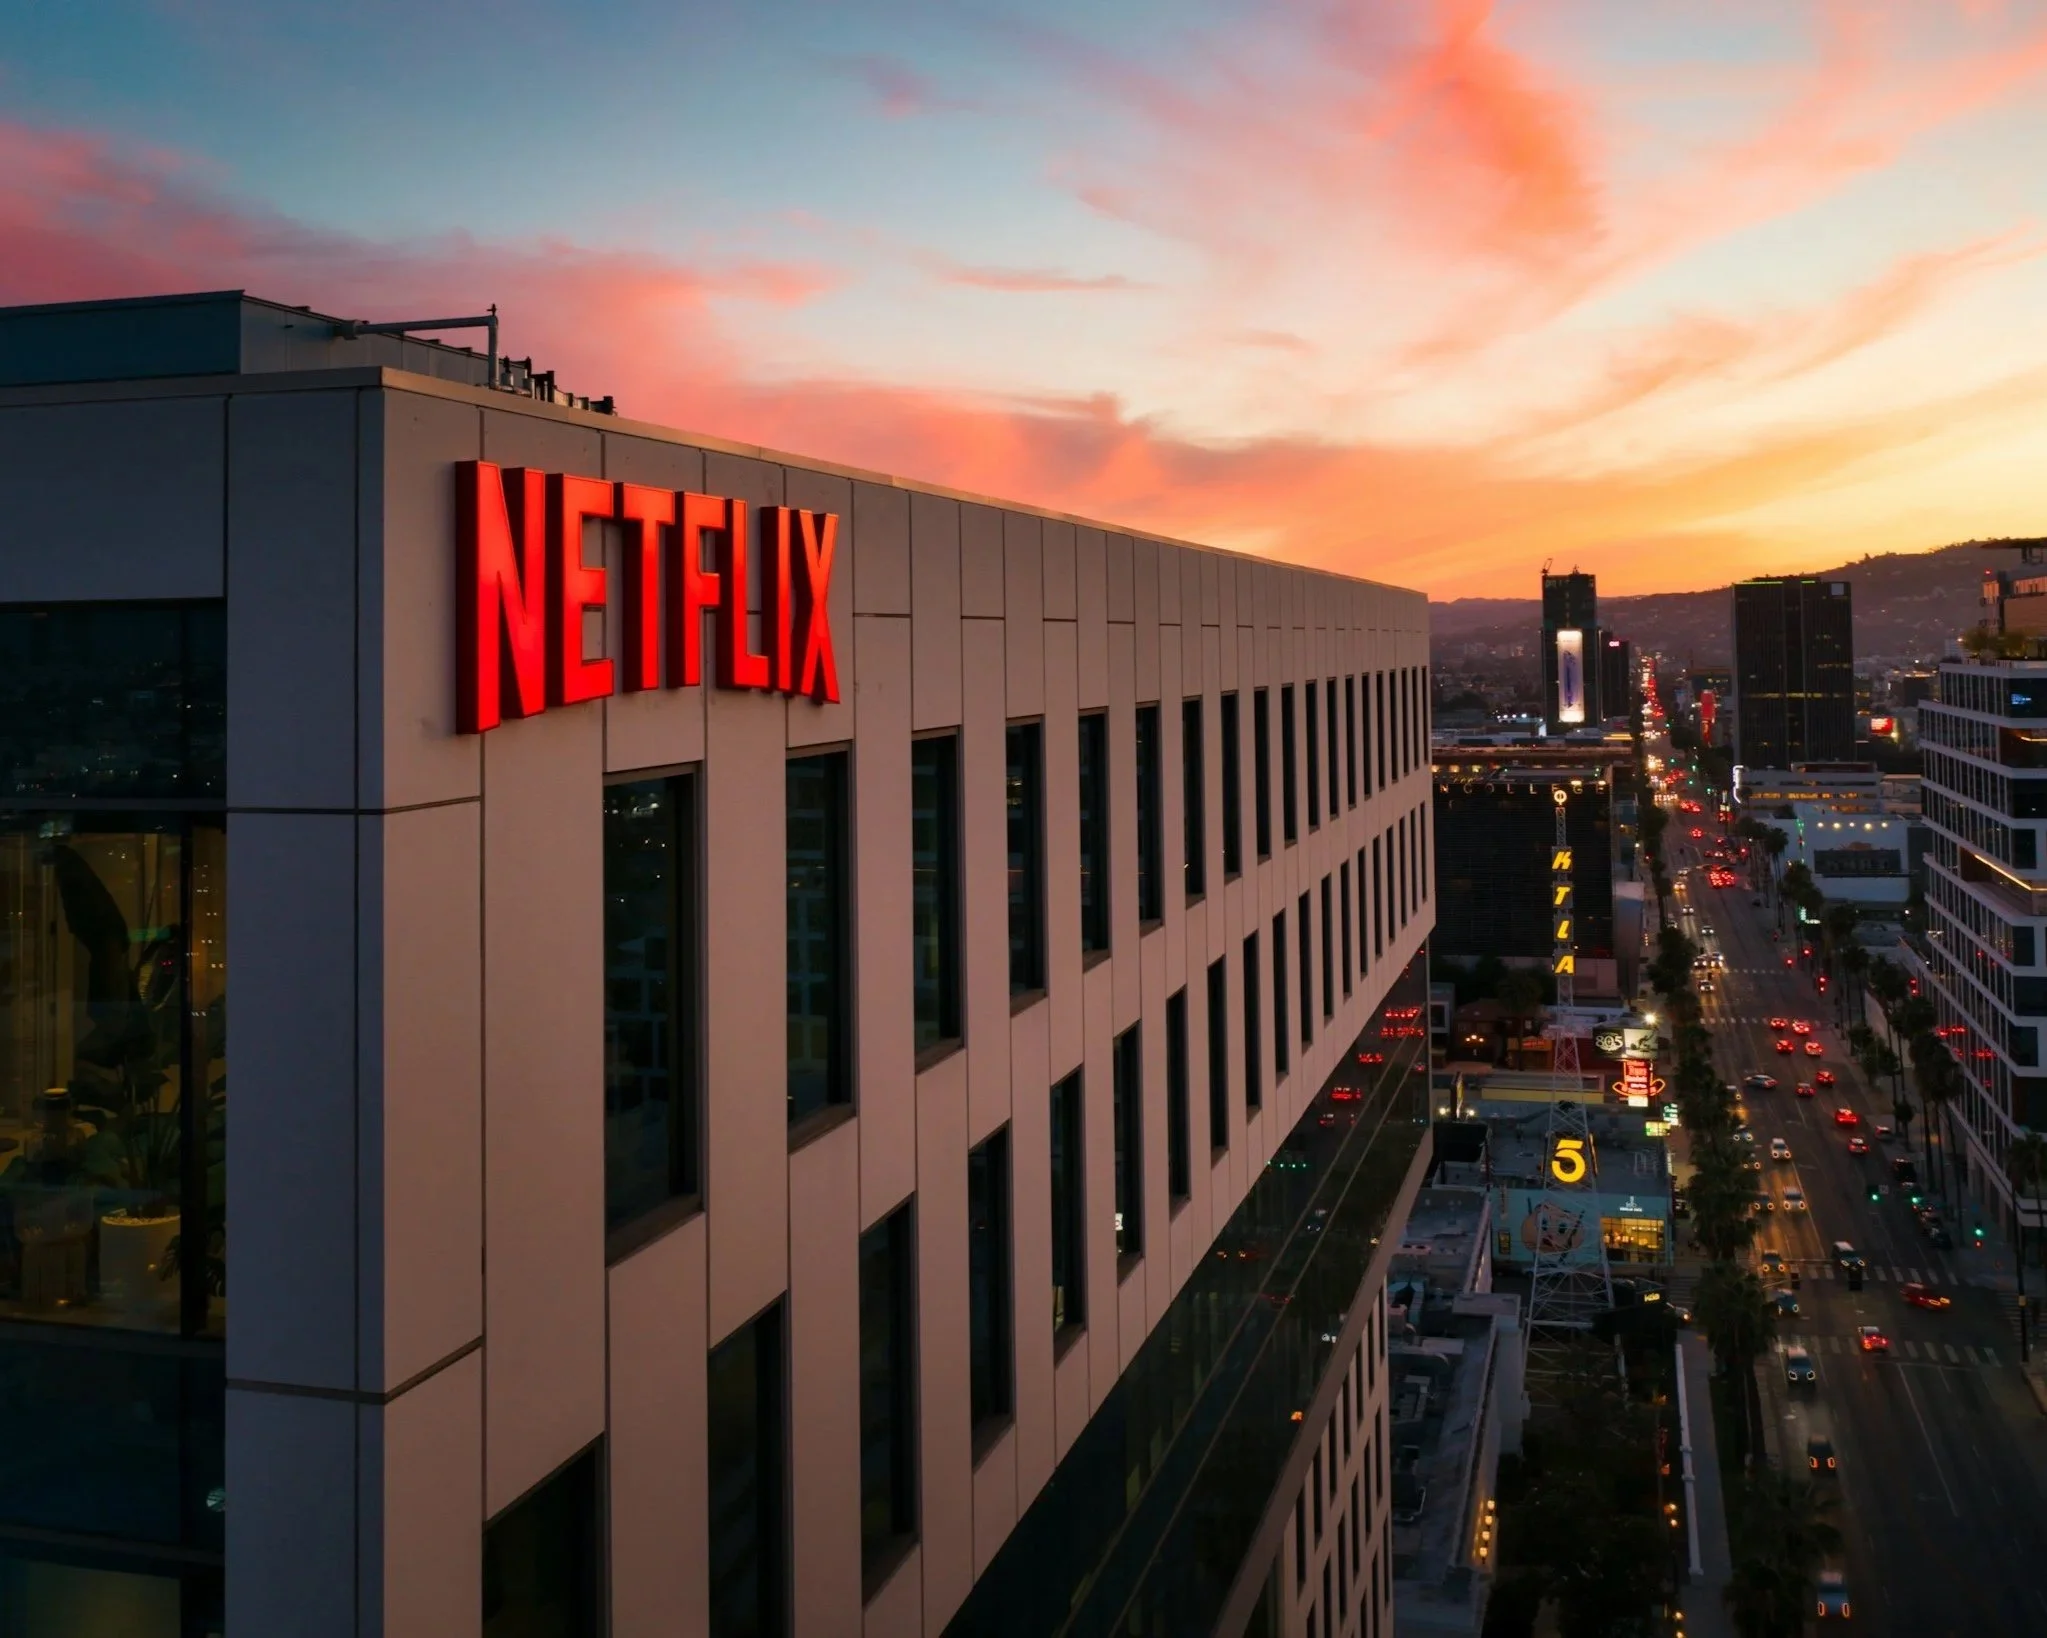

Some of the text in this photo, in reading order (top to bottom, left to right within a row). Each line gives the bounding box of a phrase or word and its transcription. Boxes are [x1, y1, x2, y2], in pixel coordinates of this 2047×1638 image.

[457, 460, 840, 734] NETFLIX
[1551, 850, 1575, 974] KTLA
[1595, 1034, 1623, 1049] 805
[1551, 1139, 1586, 1183] 5
